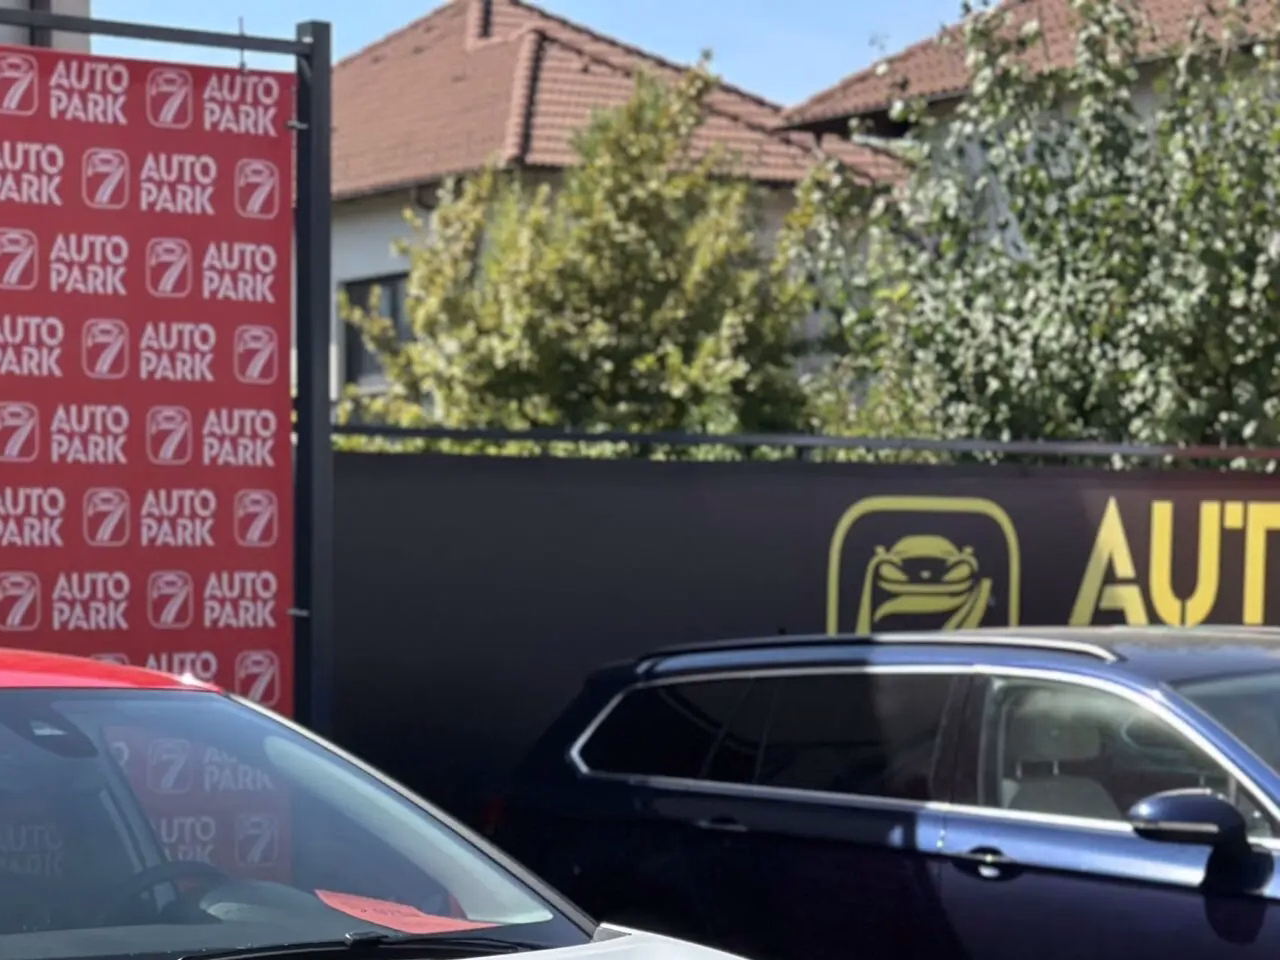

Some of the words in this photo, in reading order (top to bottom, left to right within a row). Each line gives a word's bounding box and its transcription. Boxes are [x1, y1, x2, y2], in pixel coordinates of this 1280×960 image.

[50, 61, 128, 93] AUTO
[203, 75, 279, 105] AUTO
[50, 88, 127, 124] PARK
[204, 100, 276, 136] PARK
[141, 154, 216, 184] AUTO
[141, 182, 214, 214] PARK
[50, 234, 128, 264] AUTO
[203, 242, 276, 273] AUTO
[50, 262, 126, 295] PARK
[203, 270, 274, 303] PARK
[140, 322, 216, 352] AUTO
[140, 350, 213, 381] PARK
[51, 405, 128, 434] AUTO
[203, 409, 276, 438] AUTO
[52, 433, 126, 463] PARK
[203, 436, 273, 466] PARK
[141, 489, 216, 516] AUTO
[142, 518, 213, 545] PARK
[52, 572, 130, 601] AUTO
[204, 571, 276, 600] AUTO
[53, 601, 128, 630] PARK
[205, 599, 274, 627] PARK
[161, 816, 217, 844] UTO
